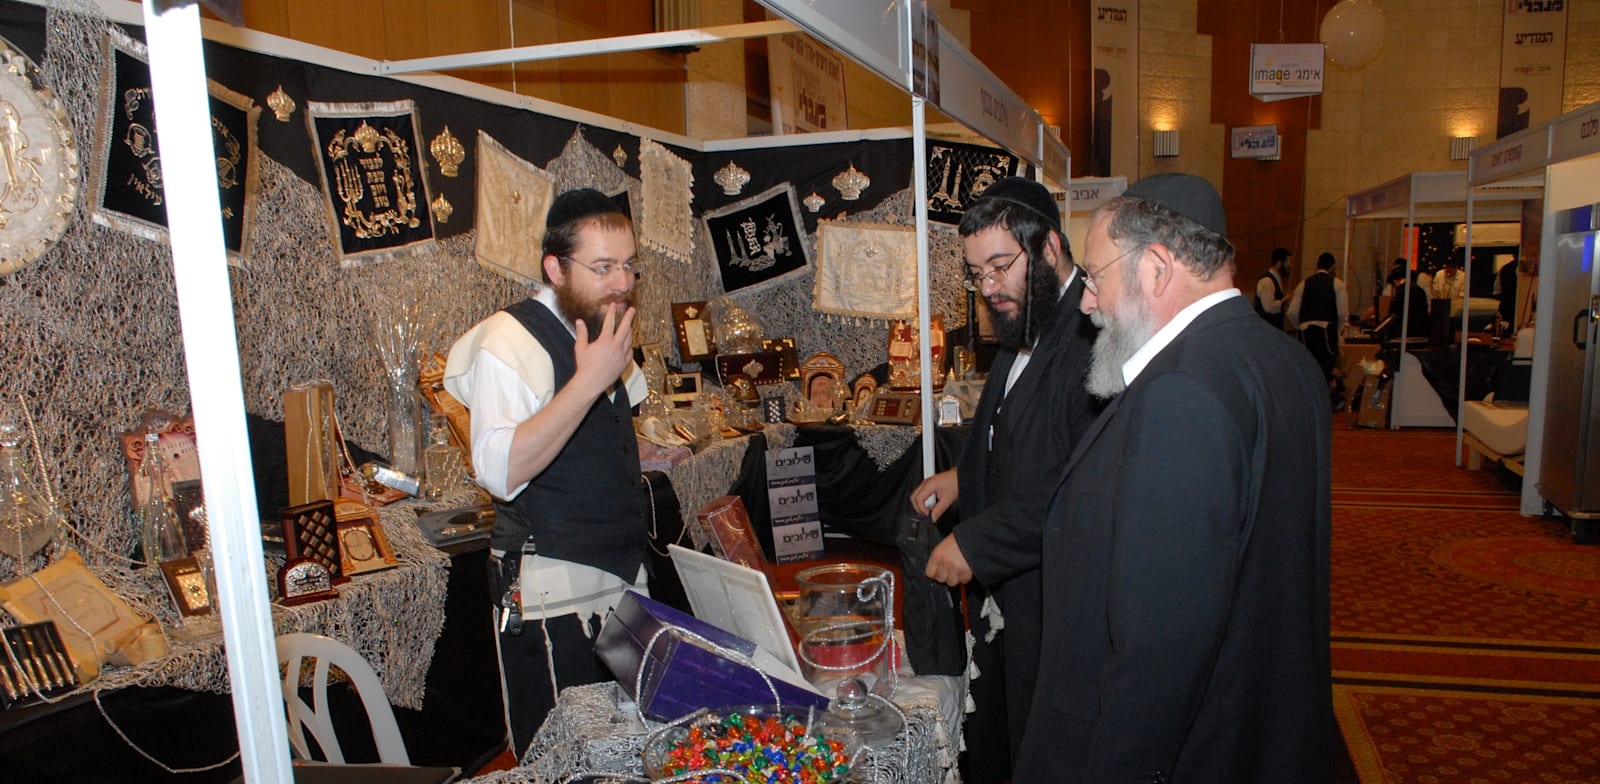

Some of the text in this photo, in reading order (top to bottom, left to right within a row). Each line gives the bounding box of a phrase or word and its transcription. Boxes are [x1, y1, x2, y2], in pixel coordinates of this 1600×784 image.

[1254, 68, 1290, 85] image
[1072, 188, 1099, 201] אביב
[775, 450, 811, 467] שילובים
[778, 489, 814, 505] שילובים
[783, 527, 819, 543] שילובים
